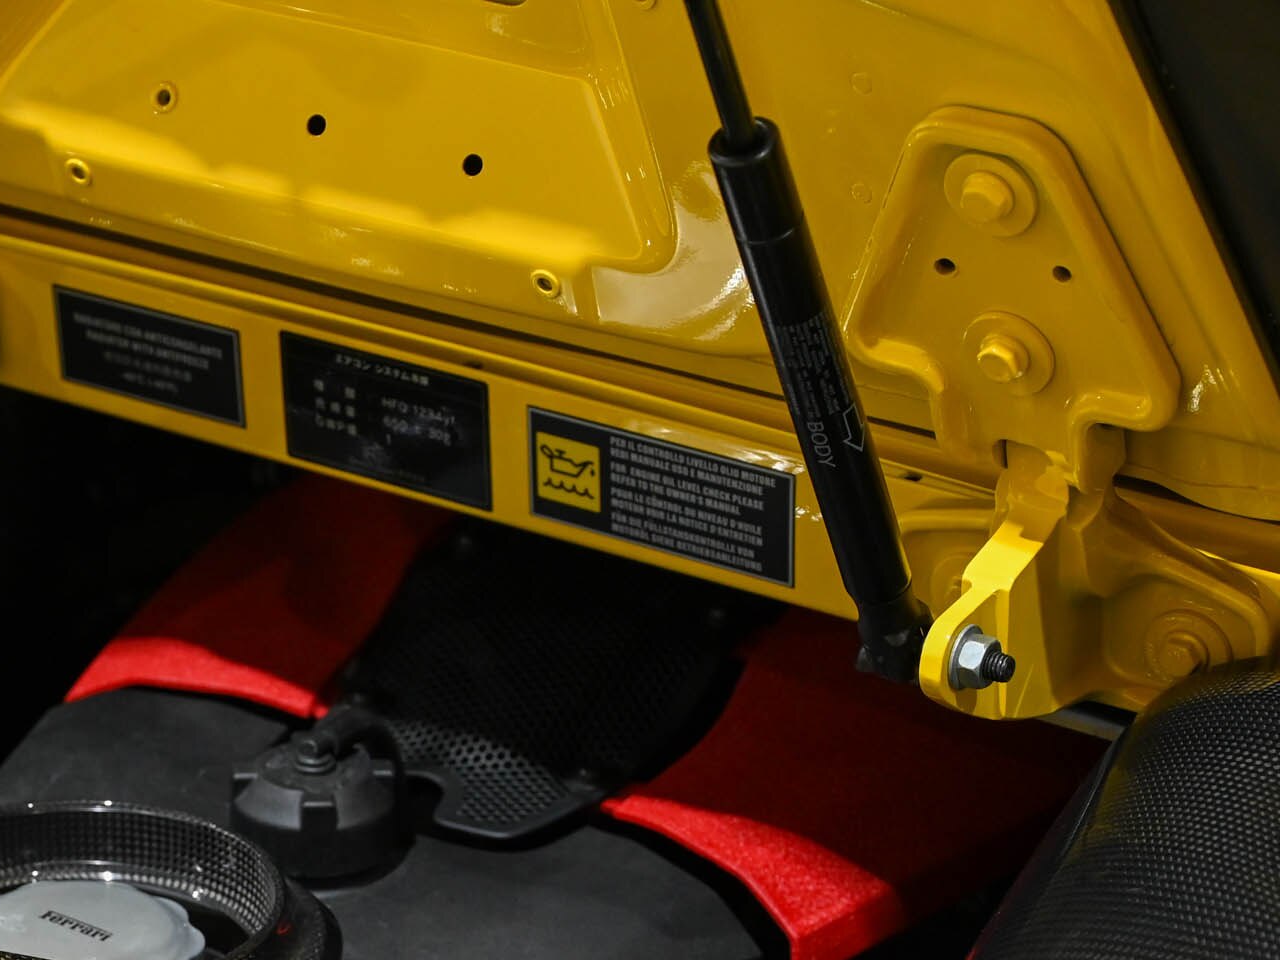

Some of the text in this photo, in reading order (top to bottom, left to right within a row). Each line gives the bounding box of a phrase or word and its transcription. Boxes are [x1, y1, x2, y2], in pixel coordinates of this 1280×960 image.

[807, 421, 837, 468] BODY
[686, 455, 718, 473] LIVELLO
[740, 470, 776, 488] MOTORE
[697, 469, 763, 496] MANUTENZIONE
[677, 478, 700, 493] LEVEL
[703, 485, 730, 501] CHECK
[731, 493, 764, 510] PLEASE
[40, 910, 112, 941] Ferrari
